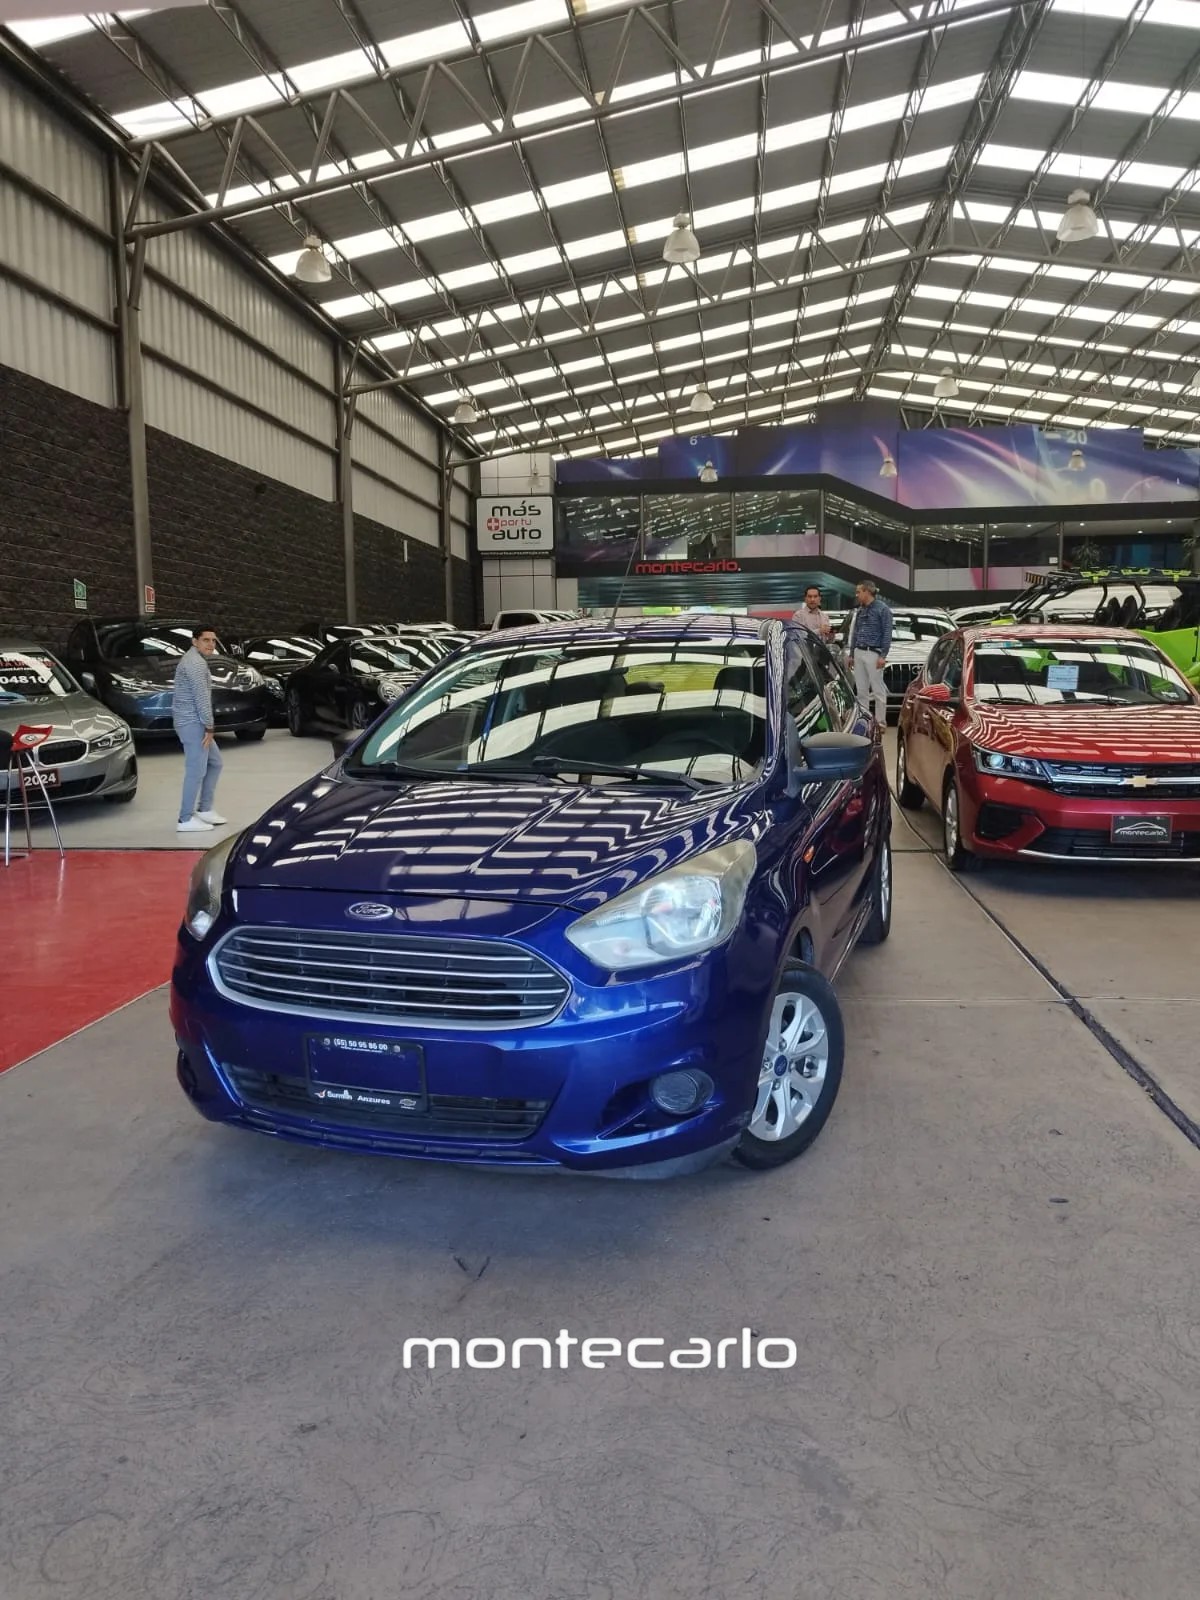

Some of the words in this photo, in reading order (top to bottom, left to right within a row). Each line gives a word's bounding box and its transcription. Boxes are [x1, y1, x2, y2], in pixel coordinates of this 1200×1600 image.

[1065, 430, 1087, 444] 20
[491, 500, 541, 517] más
[491, 527, 542, 541] auto
[23, 772, 57, 787] 2024
[357, 1095, 391, 1105] Anzures
